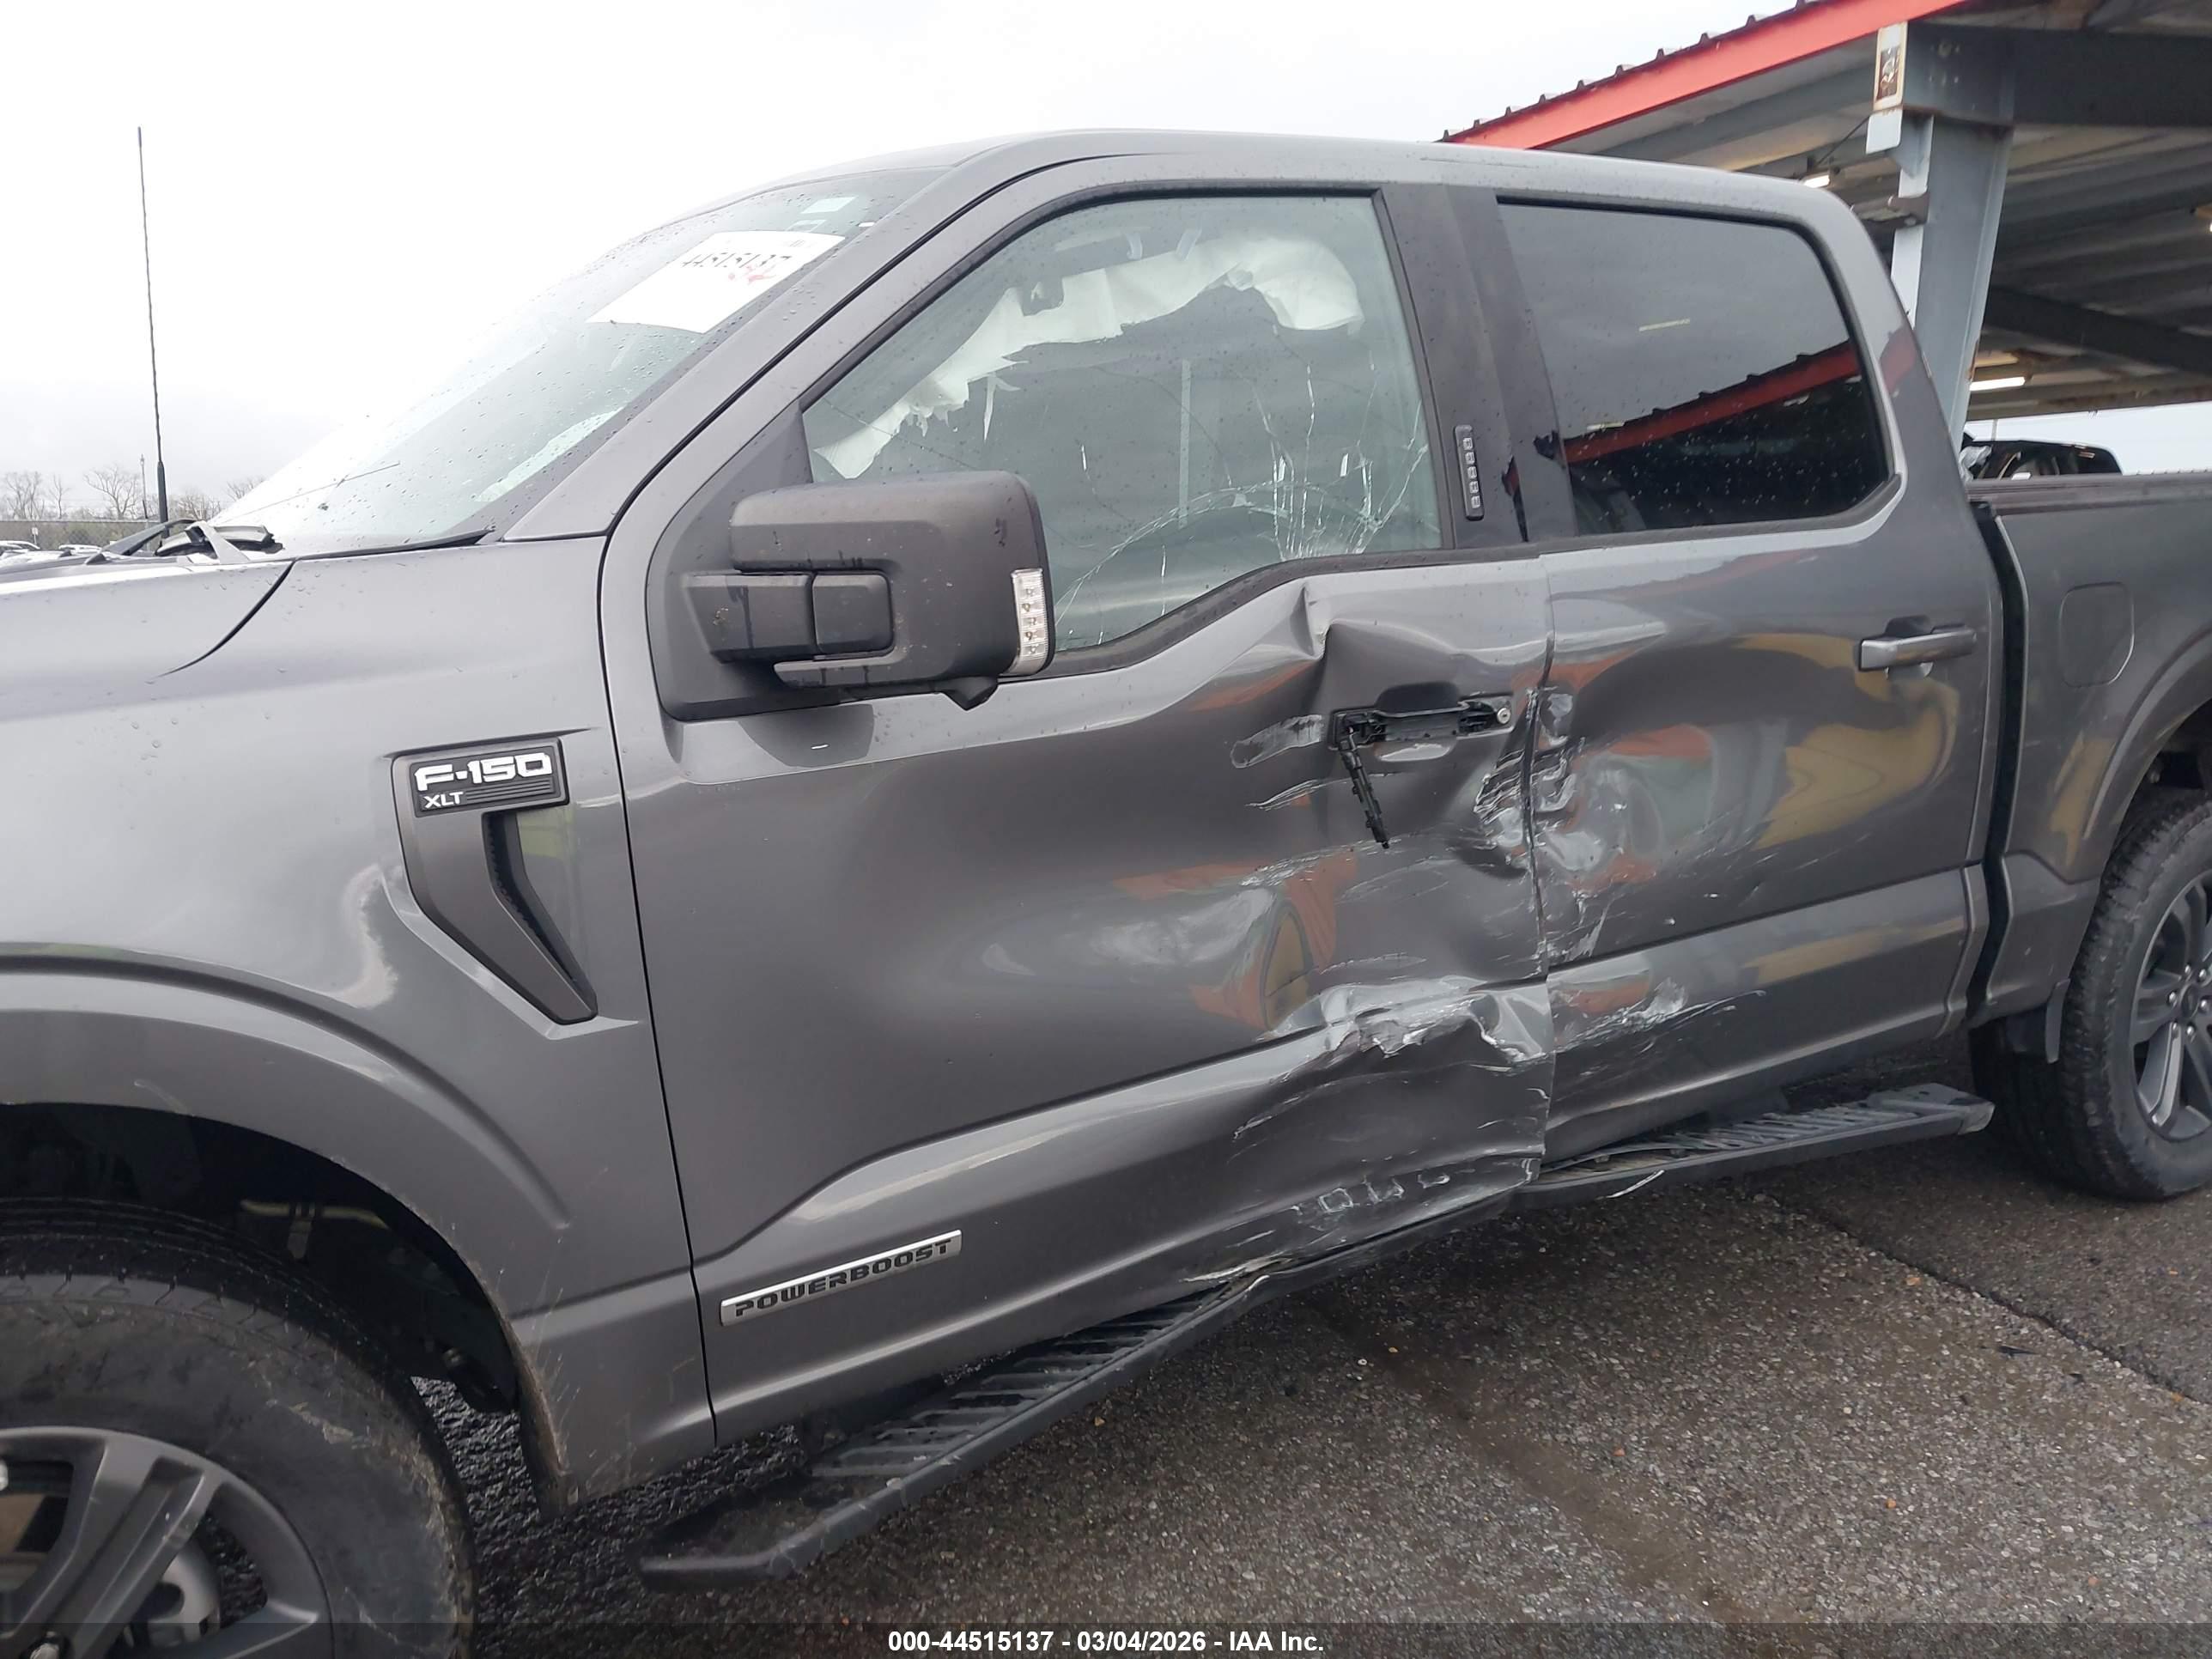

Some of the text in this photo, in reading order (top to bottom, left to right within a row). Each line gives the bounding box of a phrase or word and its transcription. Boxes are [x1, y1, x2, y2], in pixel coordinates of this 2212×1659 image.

[414, 752, 553, 792] F-150
[423, 791, 464, 809] XLT
[735, 1239, 951, 1317] POWERBOOST
